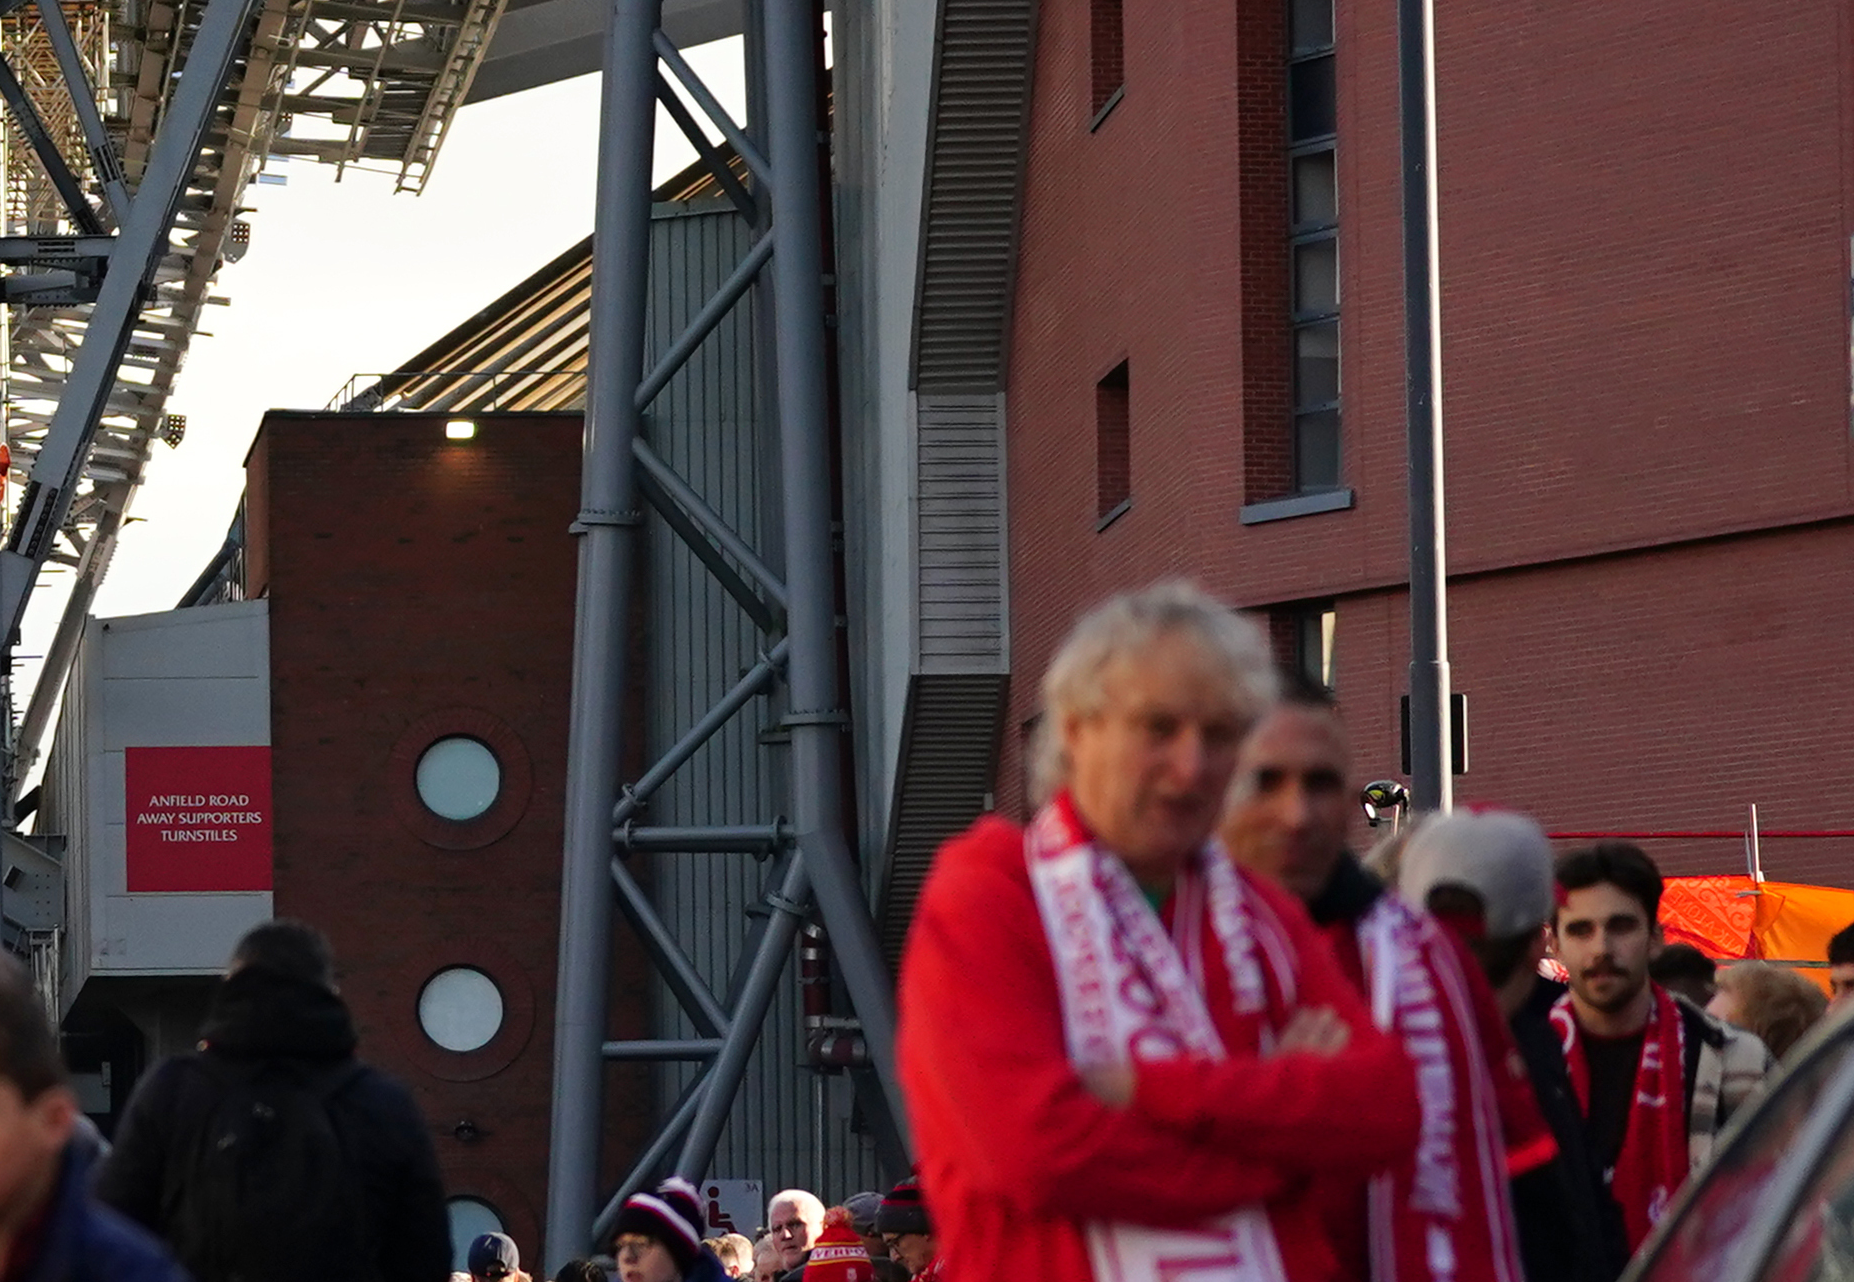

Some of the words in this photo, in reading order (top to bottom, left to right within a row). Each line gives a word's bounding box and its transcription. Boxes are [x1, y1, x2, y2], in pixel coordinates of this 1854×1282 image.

[149, 795, 205, 806] ANFIELD
[209, 794, 249, 806] ROAD
[137, 812, 175, 824] AWAY
[179, 811, 262, 824] SUPPORTERS
[161, 829, 238, 841] TURNSTILES
